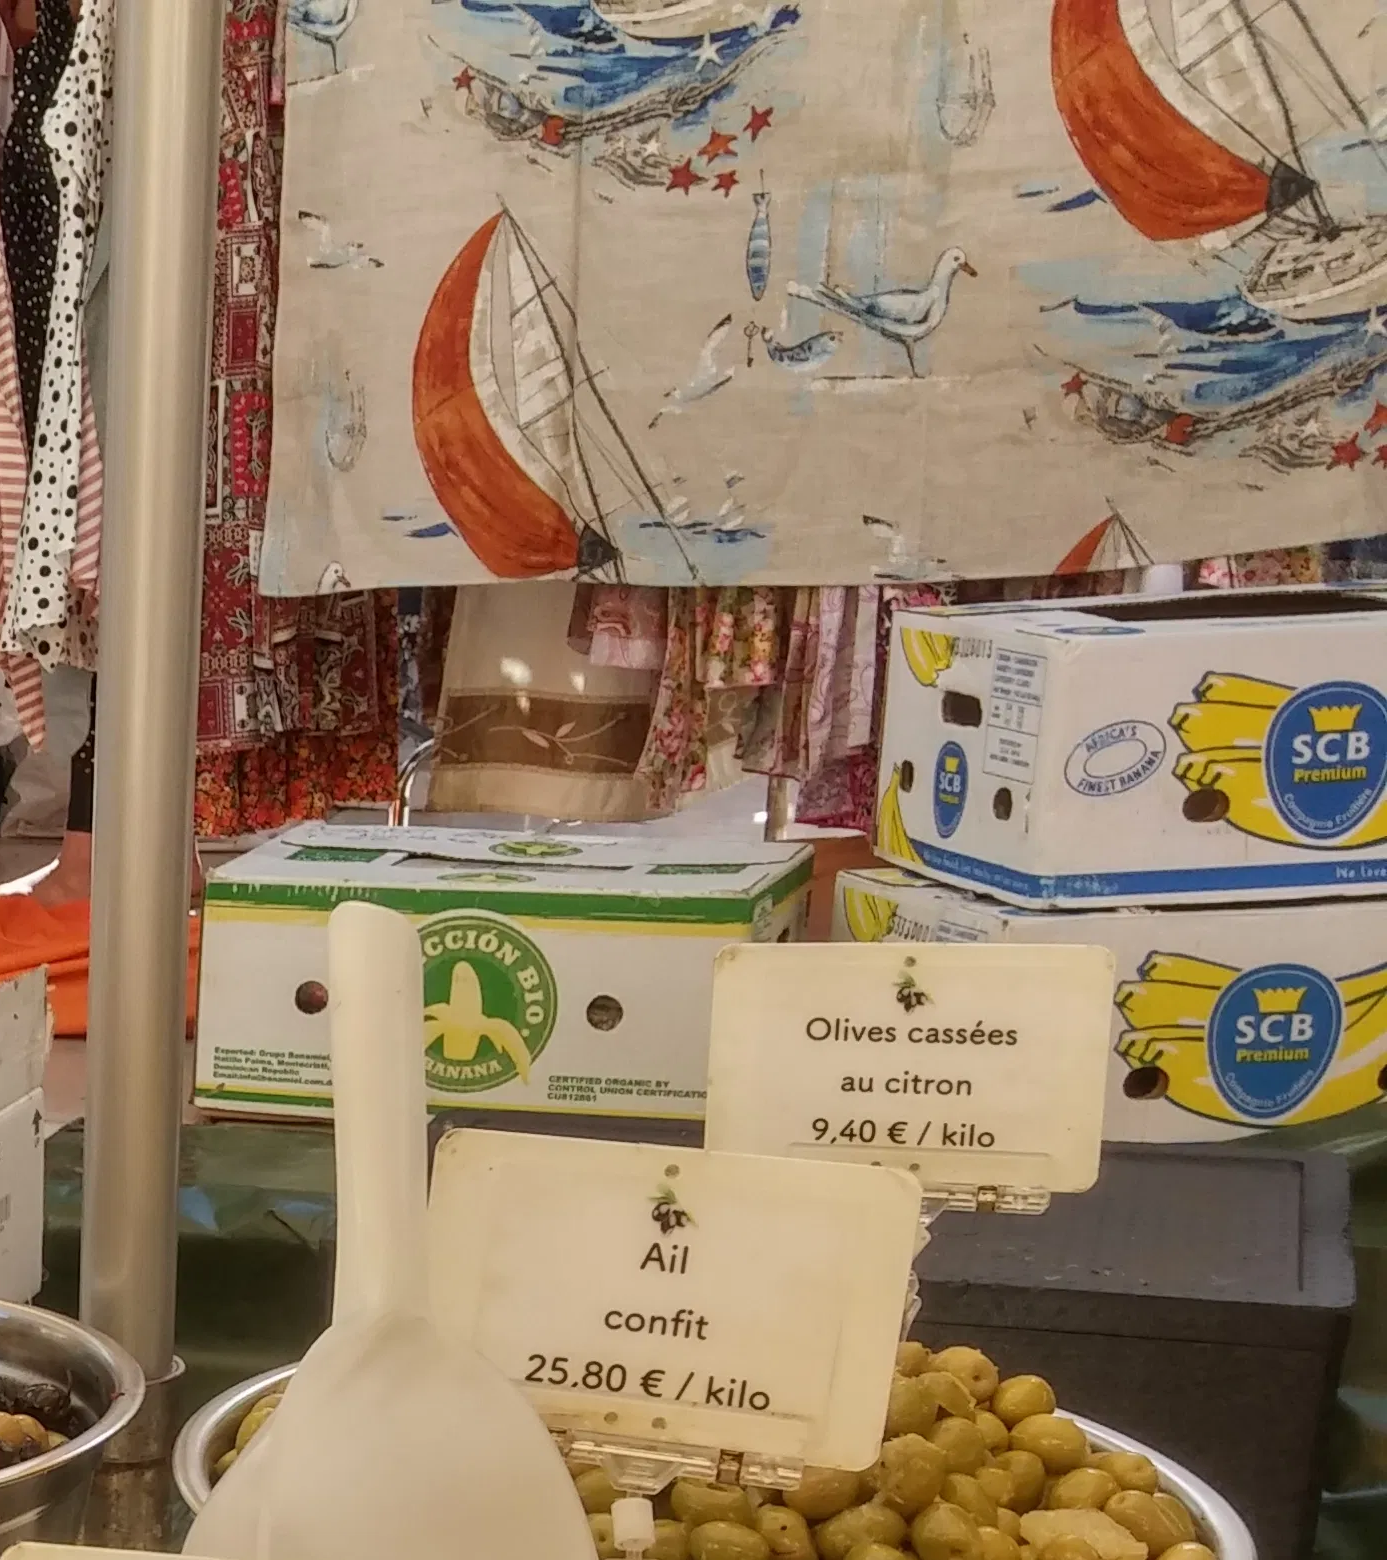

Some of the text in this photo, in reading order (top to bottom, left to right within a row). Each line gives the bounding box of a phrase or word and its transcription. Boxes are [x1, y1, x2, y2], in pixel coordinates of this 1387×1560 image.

[1291, 730, 1371, 765] SCB
[938, 771, 962, 793] SCB
[1077, 778, 1117, 793] FINEST
[1293, 765, 1367, 783] Premium
[422, 928, 545, 1025] CCIÓN BIO
[805, 1016, 1018, 1047] Olives cassées
[1234, 1013, 1314, 1045] SCB
[1235, 1046, 1310, 1063] Premium
[261, 1066, 300, 1076] Republic
[548, 1075, 671, 1089] CERTIFIED ORGANIC BY
[840, 1070, 973, 1096] au citron
[548, 1084, 708, 1099] CONTROL UNION CERTIFICATIO
[811, 1116, 995, 1148] 9,40 € / kilo
[640, 1241, 689, 1275] Ail
[604, 1307, 710, 1341] confit
[524, 1353, 771, 1412] 25,80 € / kilo
